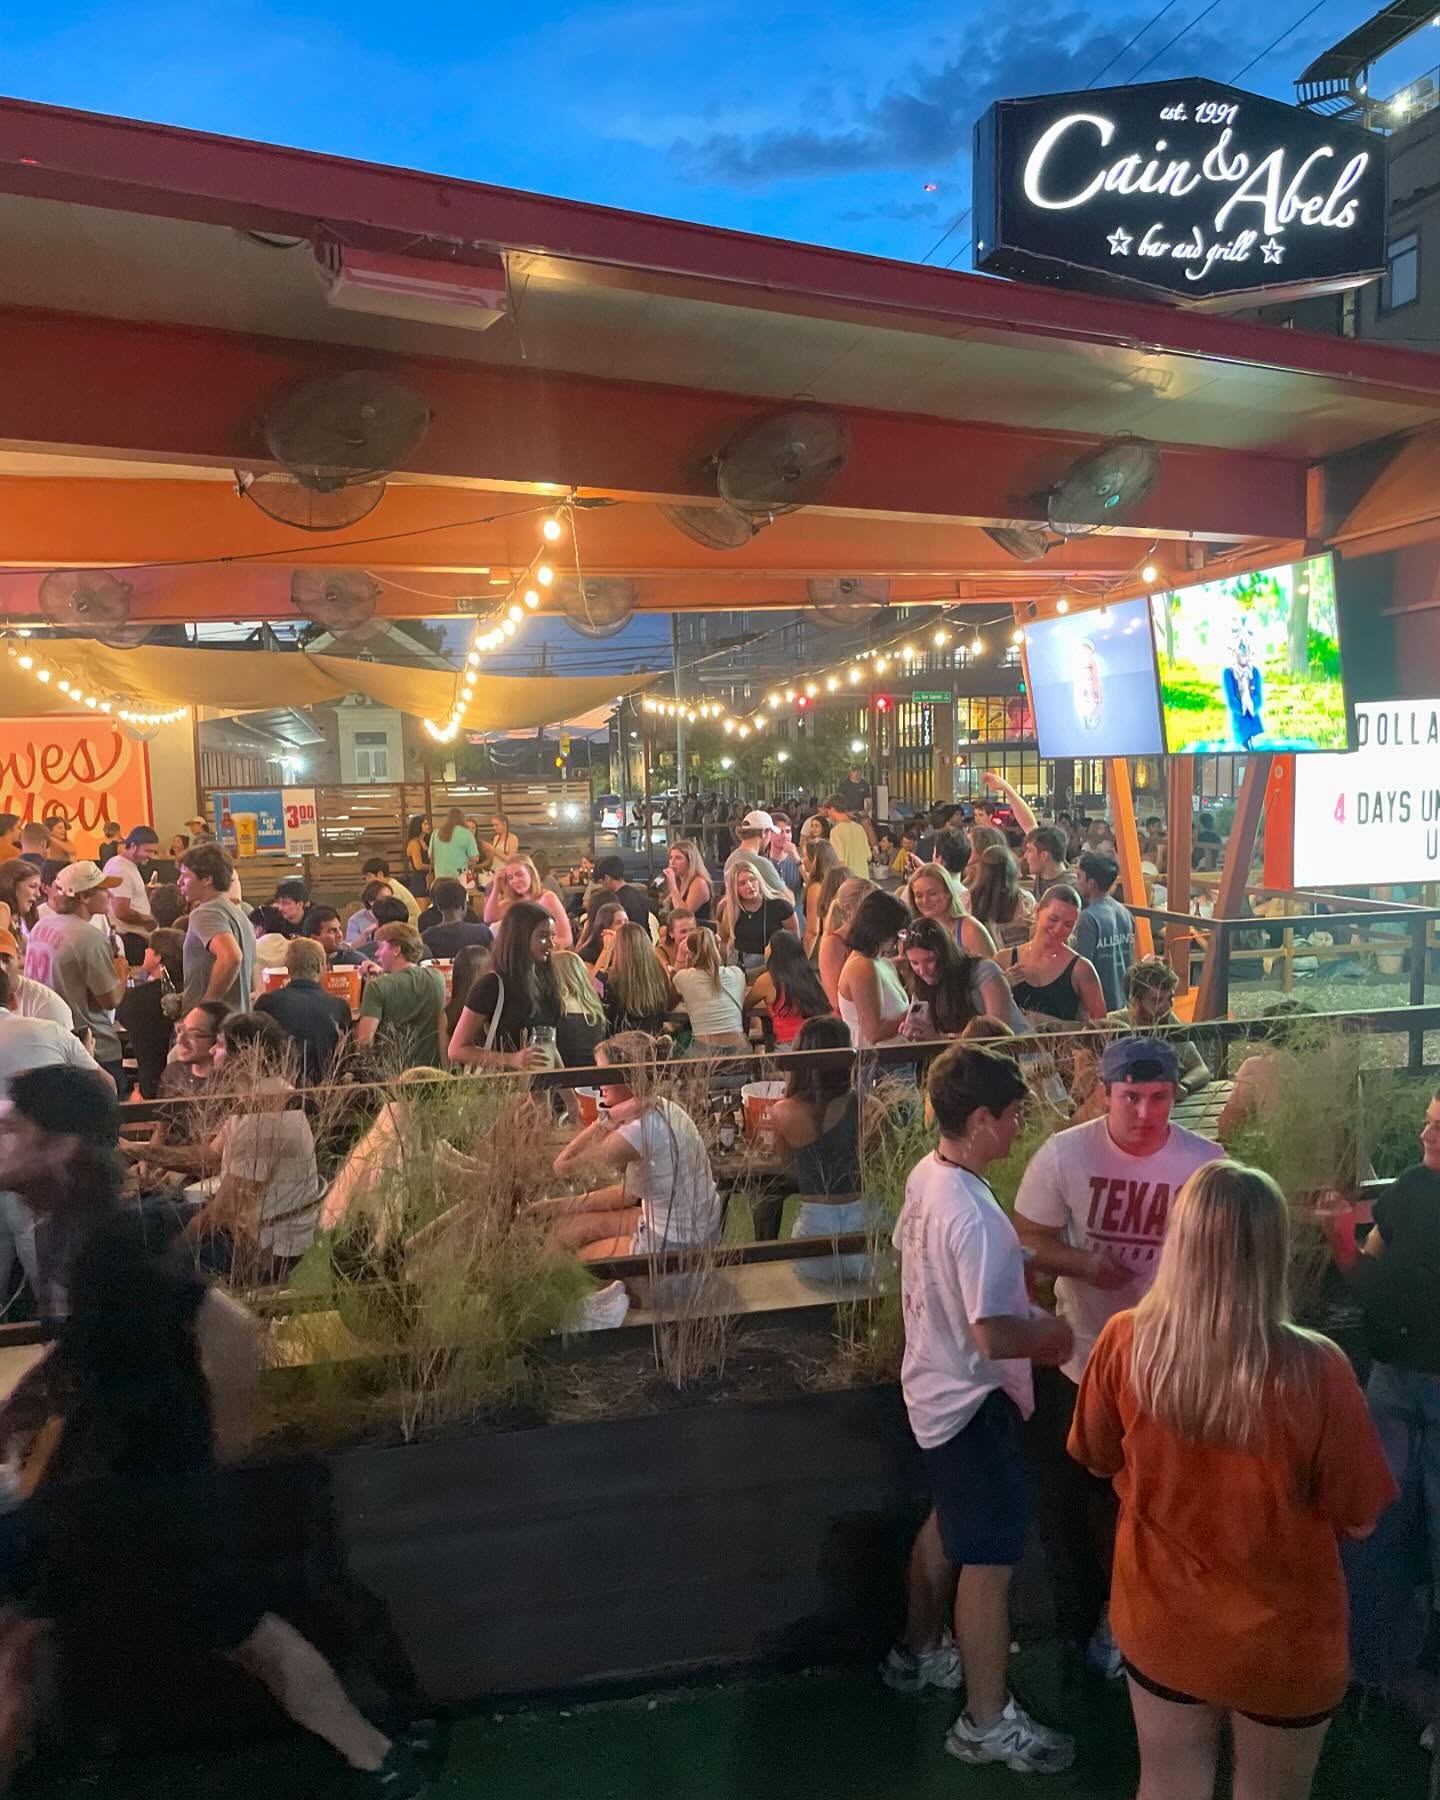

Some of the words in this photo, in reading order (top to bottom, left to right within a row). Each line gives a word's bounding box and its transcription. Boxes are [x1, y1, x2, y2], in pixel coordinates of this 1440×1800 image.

[1160, 103, 1187, 121] est.
[1195, 102, 1239, 125] 1991
[1023, 113, 1201, 210] Cain
[1202, 127, 1249, 182] &
[1214, 146, 1369, 236] Abels
[1138, 223, 1171, 257] bar
[1171, 226, 1203, 259] and
[1185, 229, 1258, 280] grill
[0, 732, 122, 789] ves
[1334, 793, 1345, 824] 4
[1358, 791, 1411, 825] DAYS
[1087, 1176, 1183, 1236] TEXA
